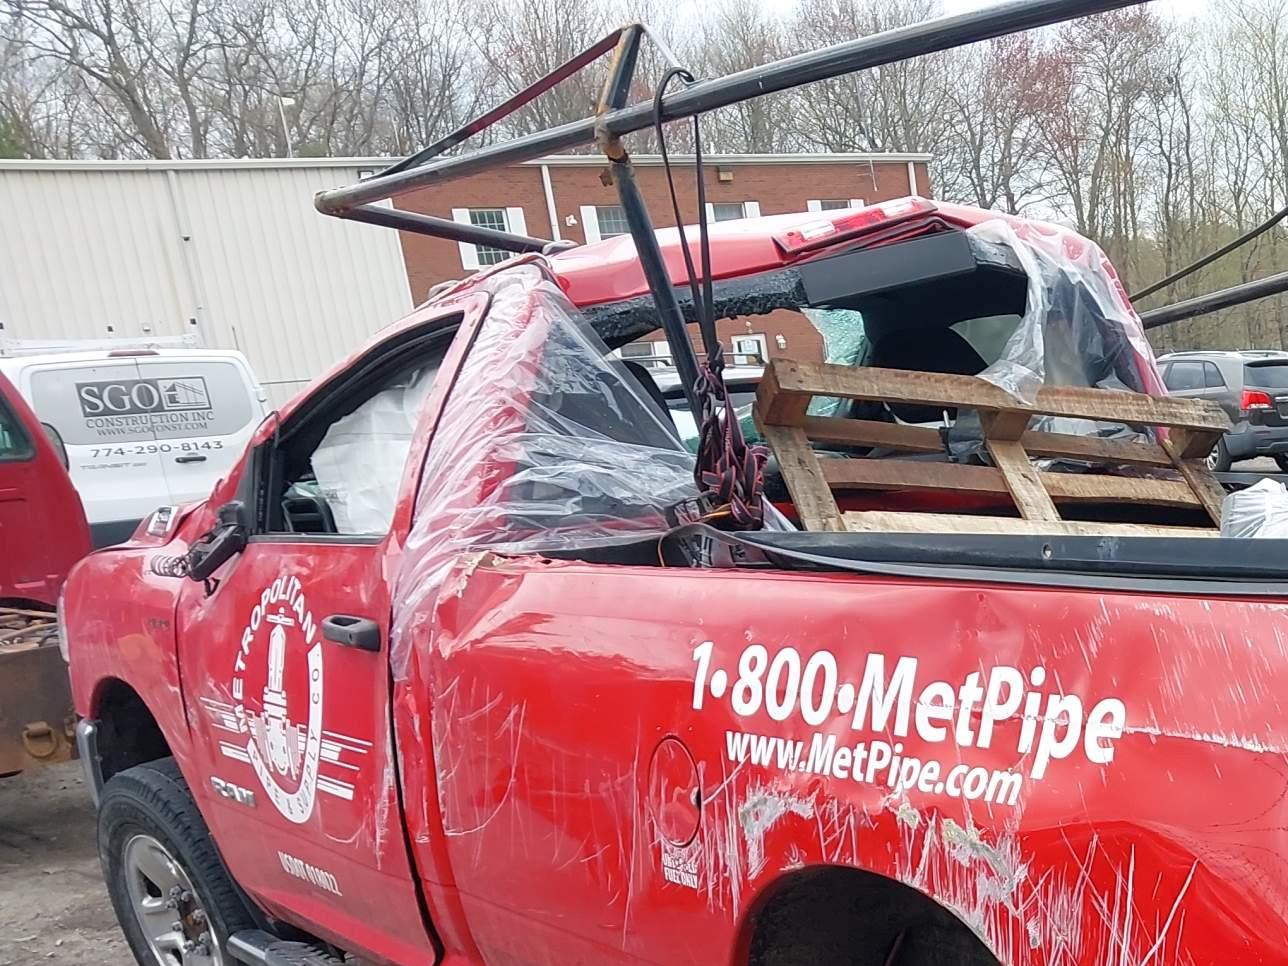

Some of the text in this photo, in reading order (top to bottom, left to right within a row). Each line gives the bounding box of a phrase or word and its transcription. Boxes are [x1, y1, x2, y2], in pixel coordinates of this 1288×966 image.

[79, 383, 160, 413] SGO
[86, 411, 215, 429] CONSTRUCTION INC
[90, 440, 224, 458] 774-290-8143
[232, 575, 317, 734] METROPOLITAN
[725, 730, 1023, 806] www.MetPipe.com
